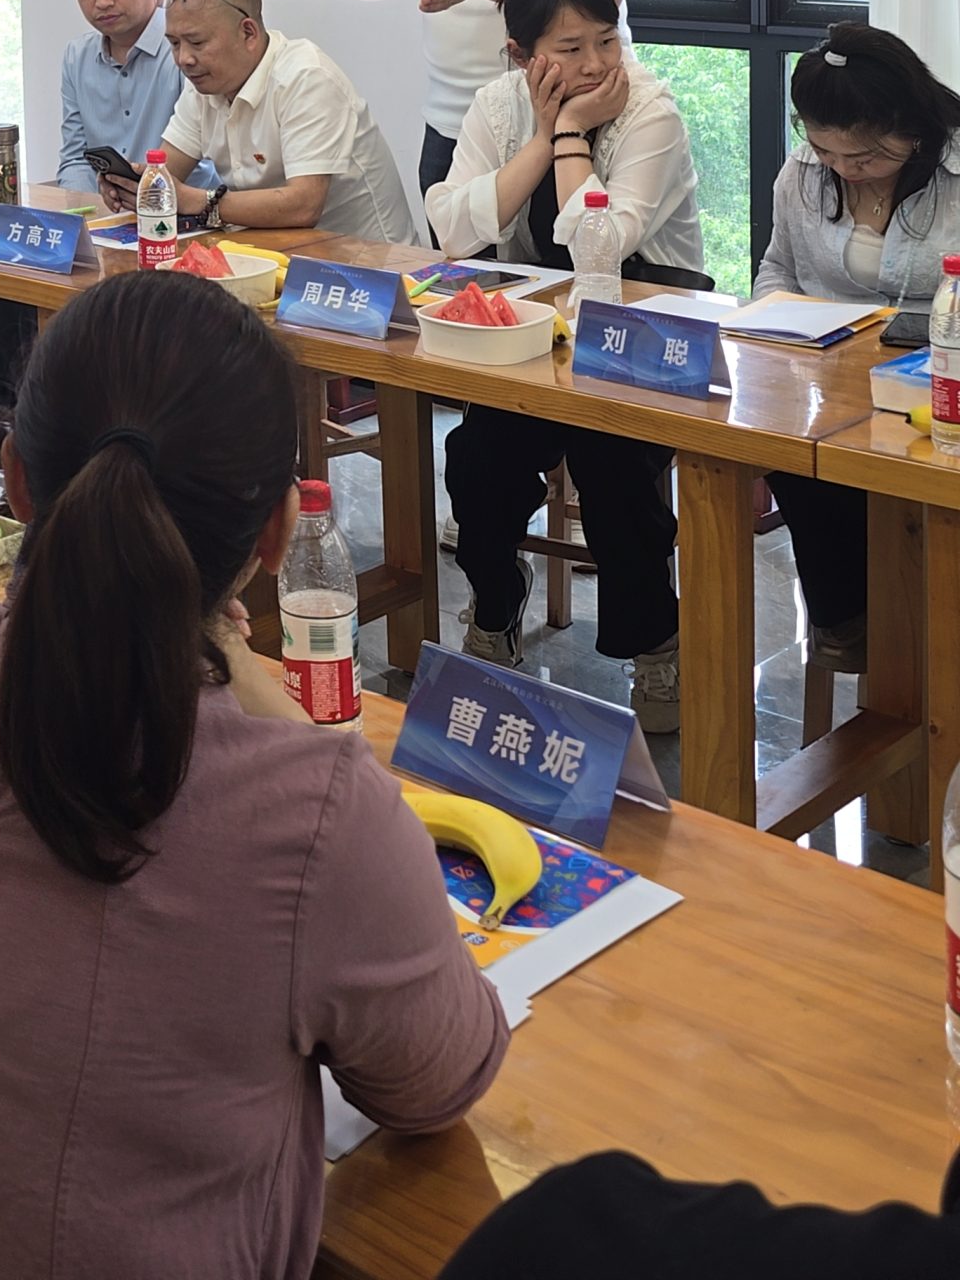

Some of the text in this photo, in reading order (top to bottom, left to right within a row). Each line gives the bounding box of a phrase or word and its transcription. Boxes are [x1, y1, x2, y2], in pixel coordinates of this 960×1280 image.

[6, 222, 64, 250] 方高平
[300, 281, 370, 313] 周月华
[445, 696, 586, 785] 曹燕妮
